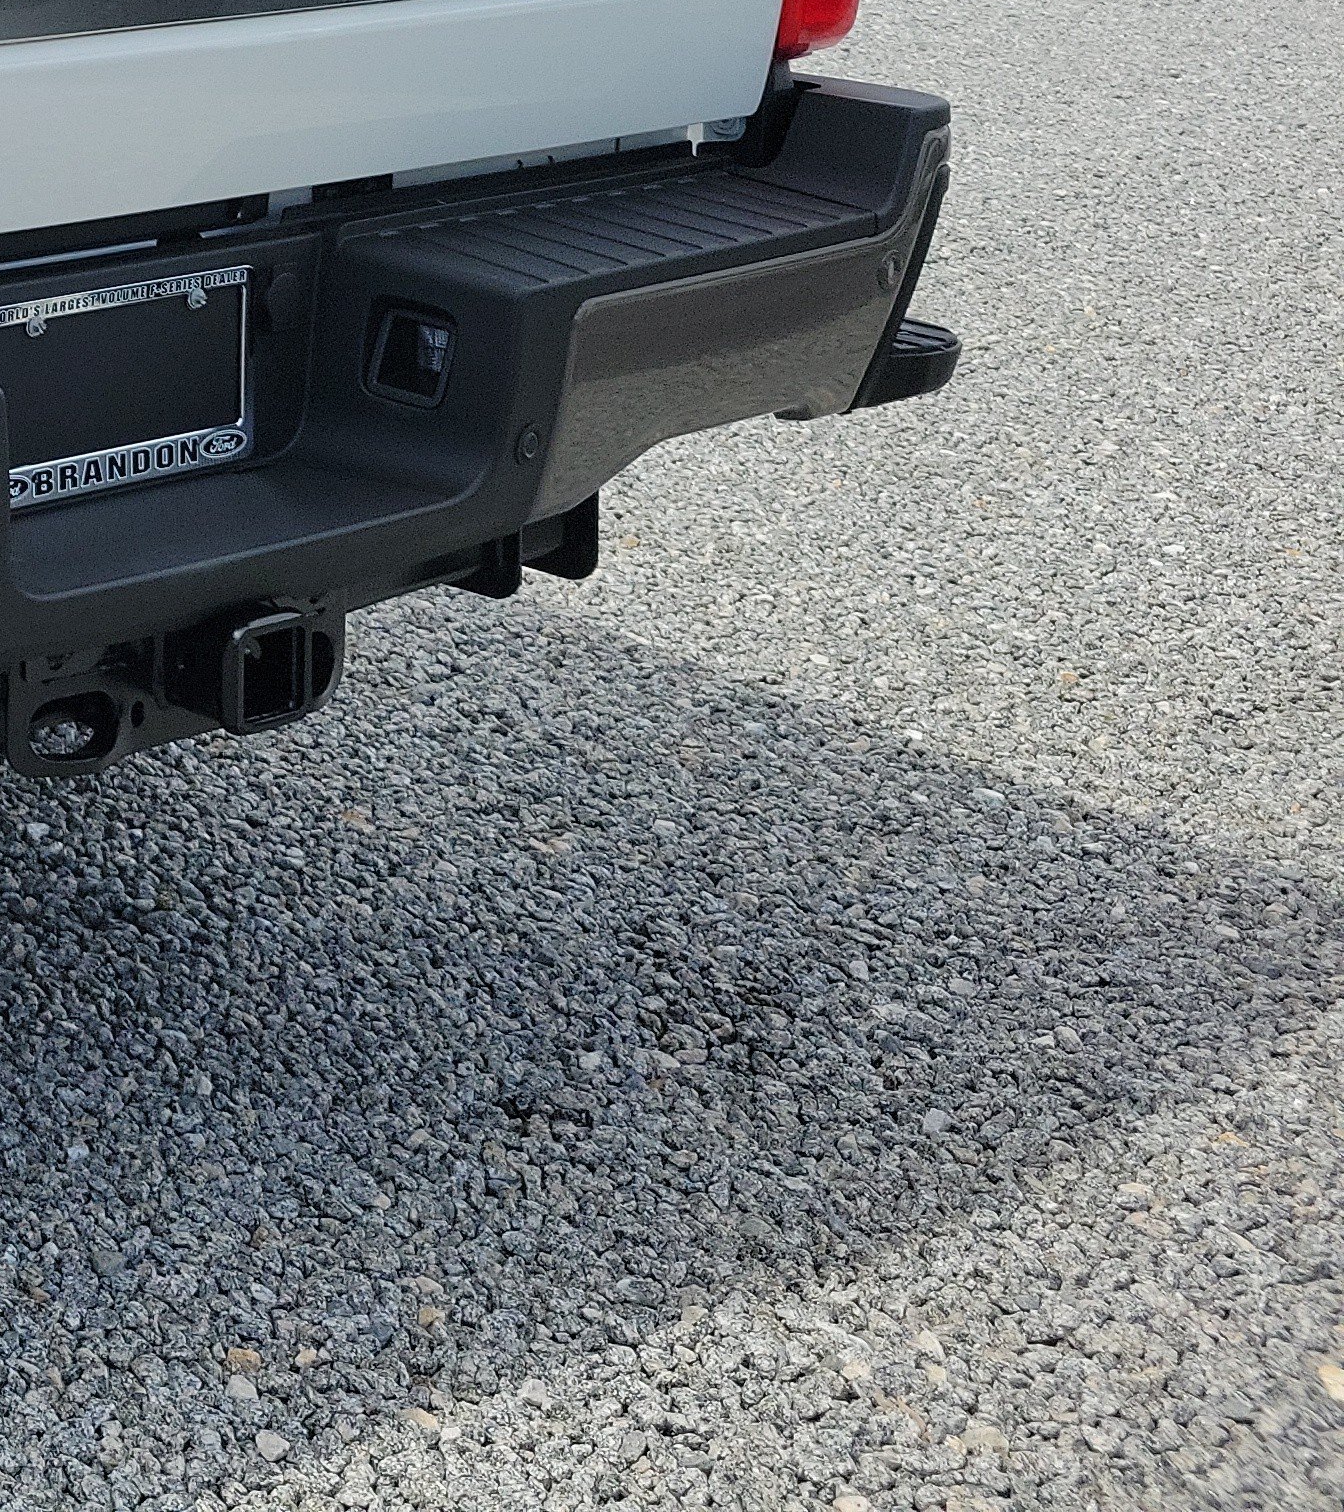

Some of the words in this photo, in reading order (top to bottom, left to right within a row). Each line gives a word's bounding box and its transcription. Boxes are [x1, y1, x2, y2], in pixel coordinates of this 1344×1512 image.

[45, 295, 98, 315] LARGEST
[100, 284, 147, 304] VOLUME
[149, 277, 202, 297] F-SERIES
[204, 269, 247, 288] DEALER
[31, 436, 200, 499] BRANDON
[210, 434, 239, 453] Ford
